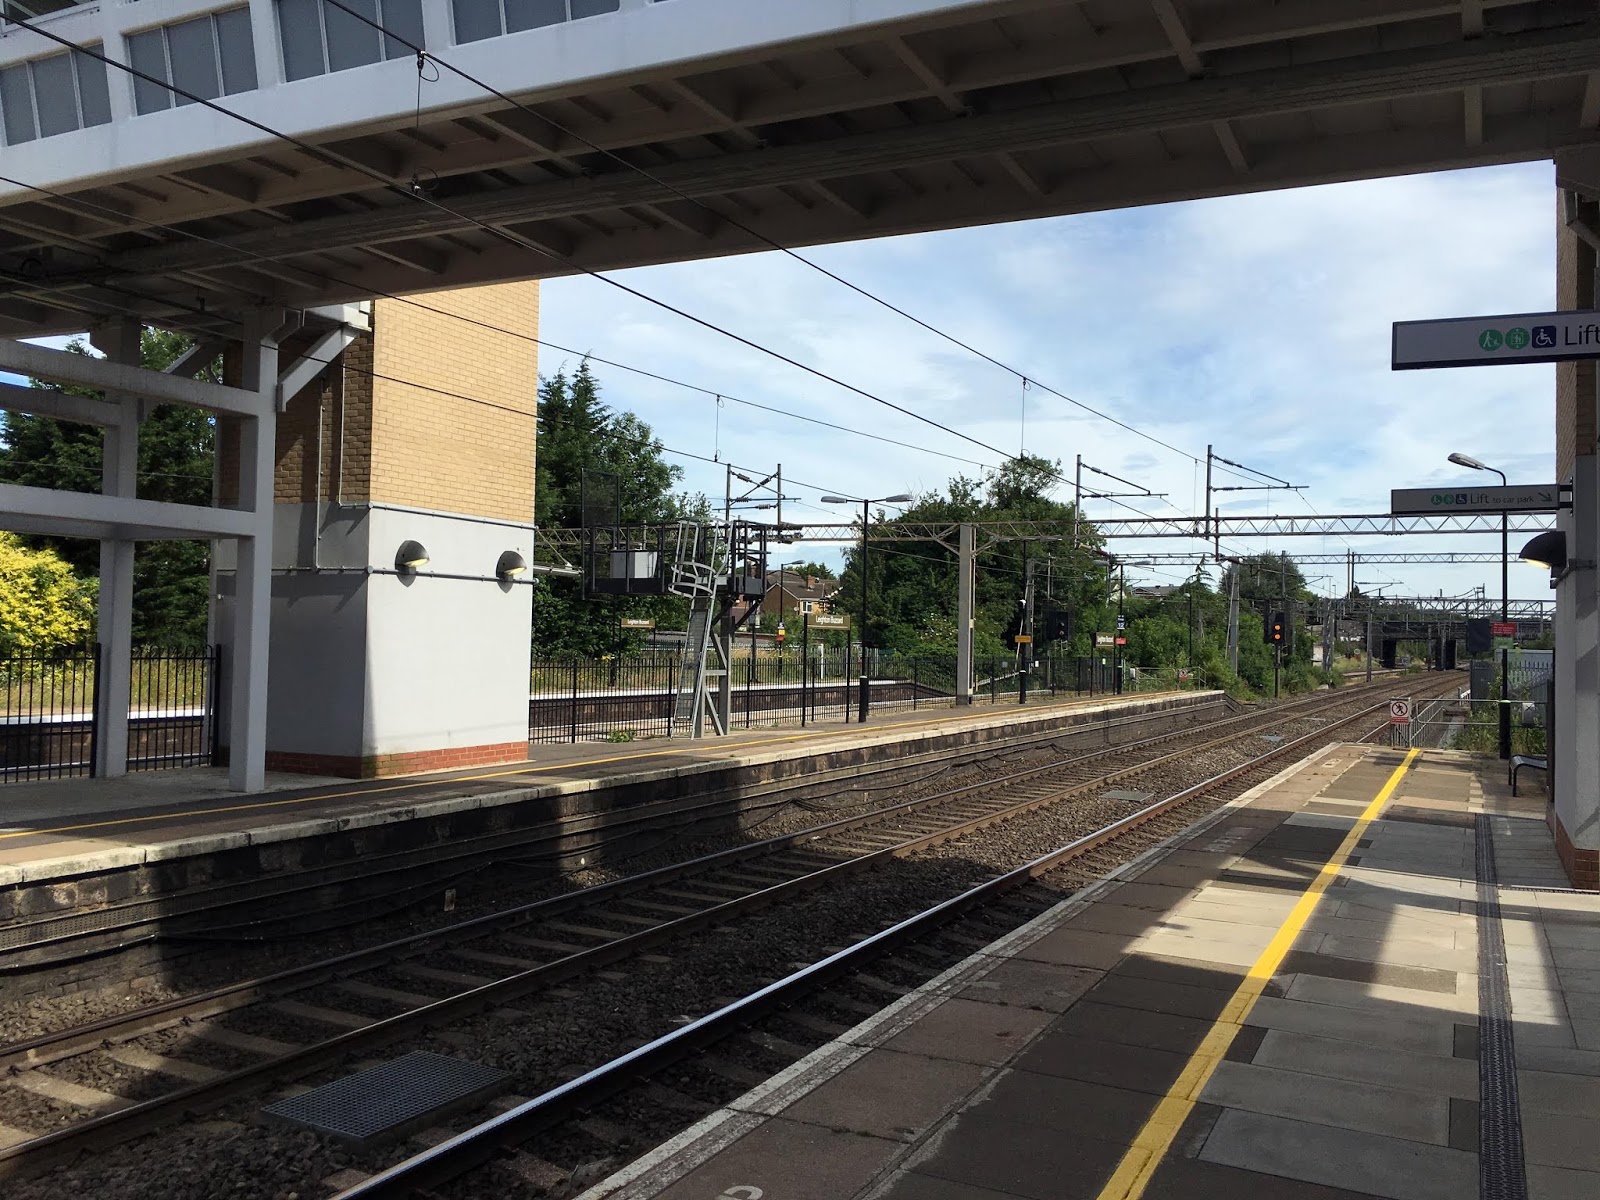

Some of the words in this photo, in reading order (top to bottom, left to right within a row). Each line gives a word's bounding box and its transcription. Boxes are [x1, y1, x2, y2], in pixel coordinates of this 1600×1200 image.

[1565, 324, 1600, 345] Lift
[1470, 493, 1490, 504] Lift
[1503, 496, 1515, 504] car
[1517, 495, 1535, 505] park
